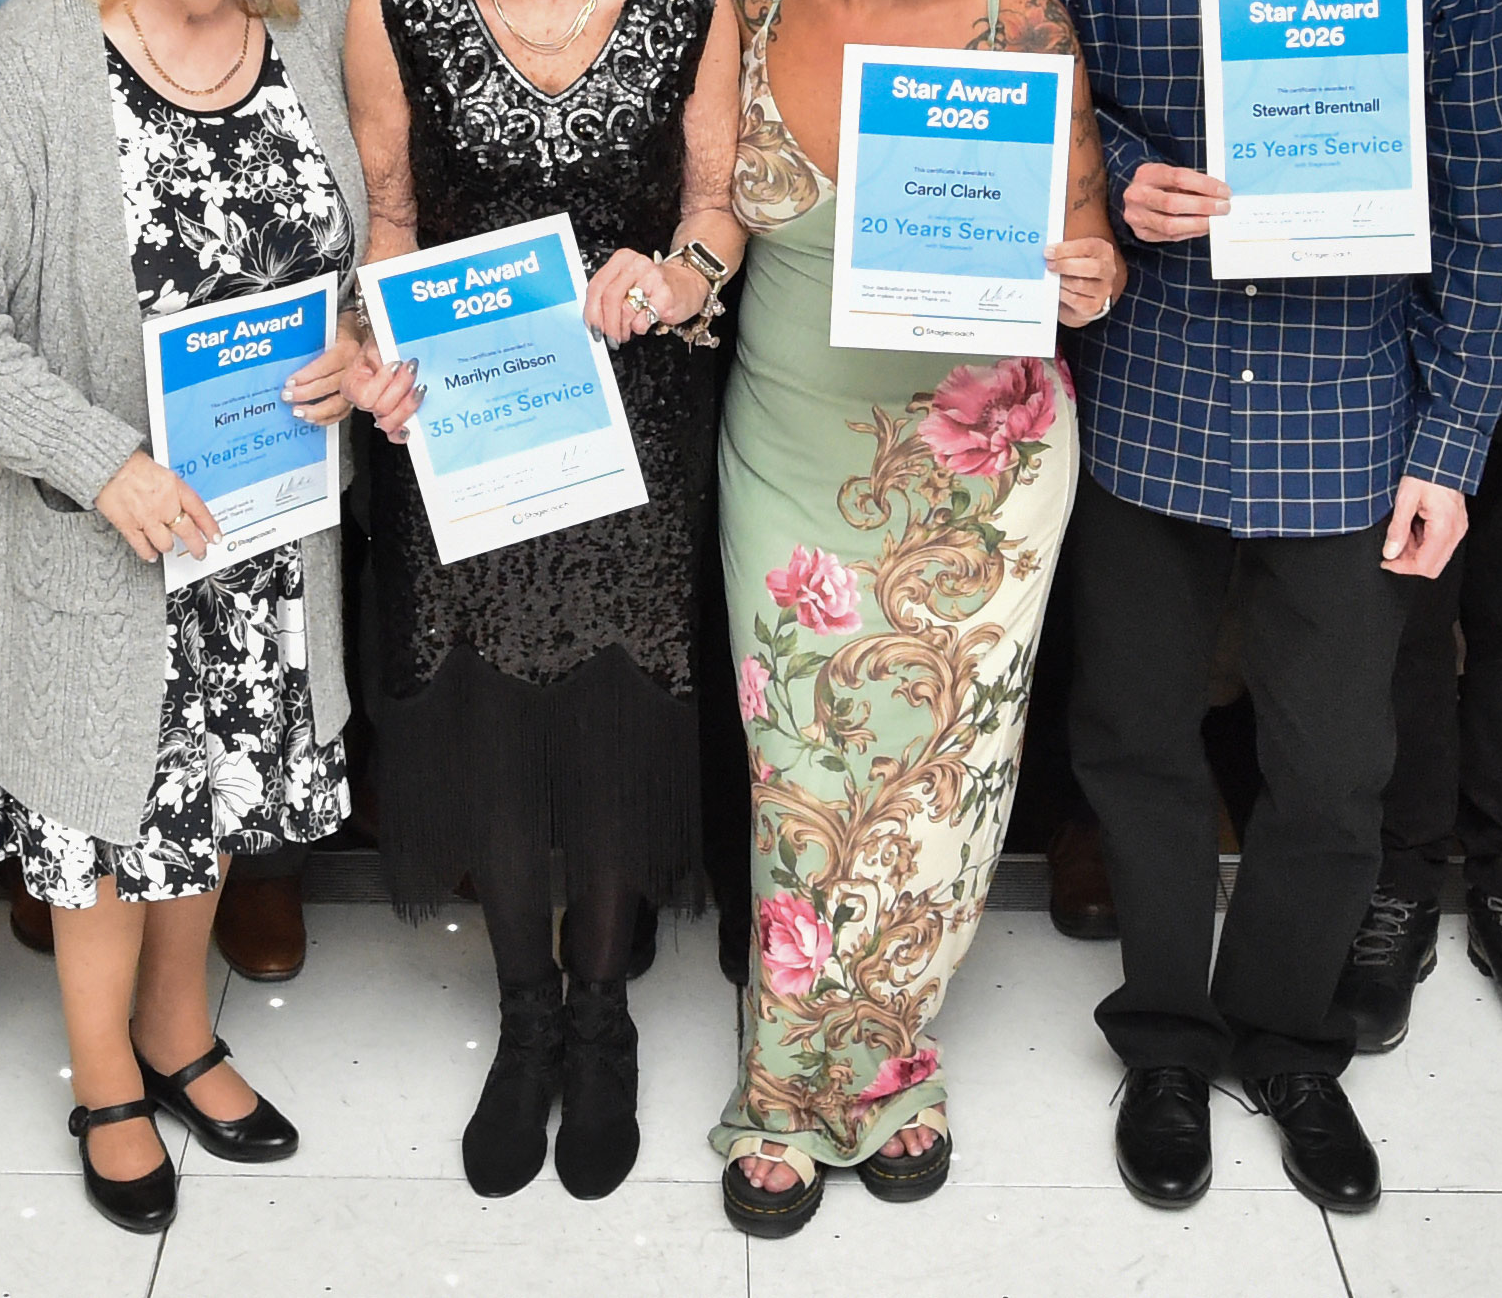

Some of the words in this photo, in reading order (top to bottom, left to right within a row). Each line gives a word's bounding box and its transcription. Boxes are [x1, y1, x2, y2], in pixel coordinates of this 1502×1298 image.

[1249, 1, 1297, 24] Star
[1285, 26, 1346, 49] 2026
[892, 76, 942, 100] Star
[946, 79, 1028, 105] Award
[927, 107, 990, 130] 2026
[1252, 103, 1311, 118] Stewart
[1315, 98, 1380, 115] Brentnall
[1232, 142, 1257, 160] 25
[1263, 140, 1318, 158] Years
[1325, 136, 1403, 156] Service
[904, 181, 946, 197] Carol
[950, 183, 1001, 200] Clarke
[861, 217, 888, 234] 20
[896, 218, 952, 239] Years
[958, 222, 1040, 244] Service
[411, 276, 459, 302] Star
[465, 251, 539, 290] Award
[452, 287, 512, 319] 2026
[186, 329, 228, 353] Star
[233, 307, 303, 341] Award
[218, 339, 272, 367] 2026
[445, 365, 500, 390] Marilyn
[503, 352, 556, 374] Gibson
[214, 410, 240, 428] Kim
[428, 417, 454, 438] 35
[457, 403, 512, 428] Years
[517, 382, 594, 412] Service
[174, 460, 197, 479] 30
[202, 442, 247, 468] Years
[253, 424, 320, 451] Service
